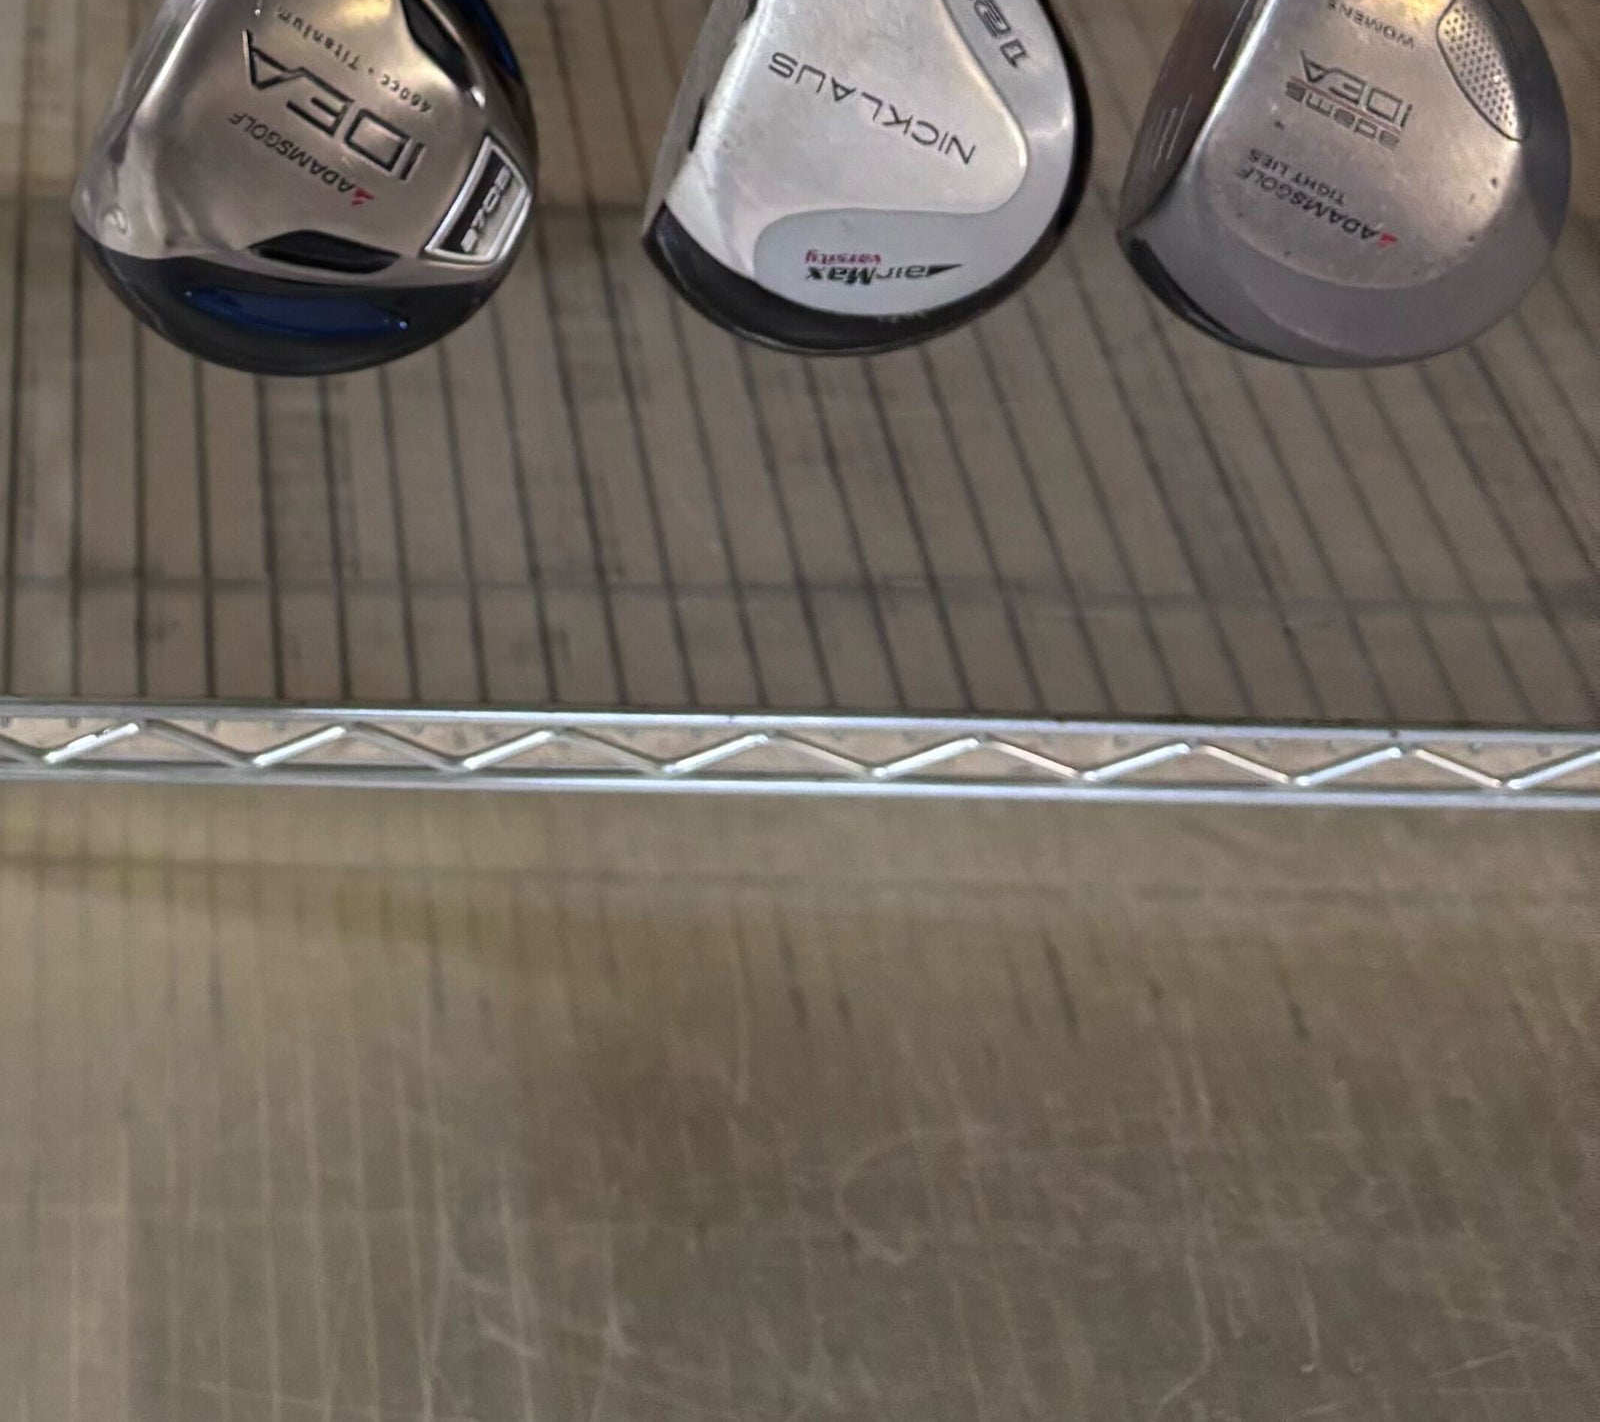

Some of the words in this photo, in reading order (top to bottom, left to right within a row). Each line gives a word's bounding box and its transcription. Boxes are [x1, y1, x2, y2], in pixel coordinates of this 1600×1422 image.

[242, 28, 426, 180] IDEA
[768, 50, 975, 164] NICKLAUS
[1300, 50, 1412, 129] IDEA
[230, 111, 357, 193] ADAMSGOLF
[1248, 147, 1290, 177] LIES
[1295, 167, 1346, 205] TIGHT
[1235, 166, 1378, 241] ADAMSGOLF
